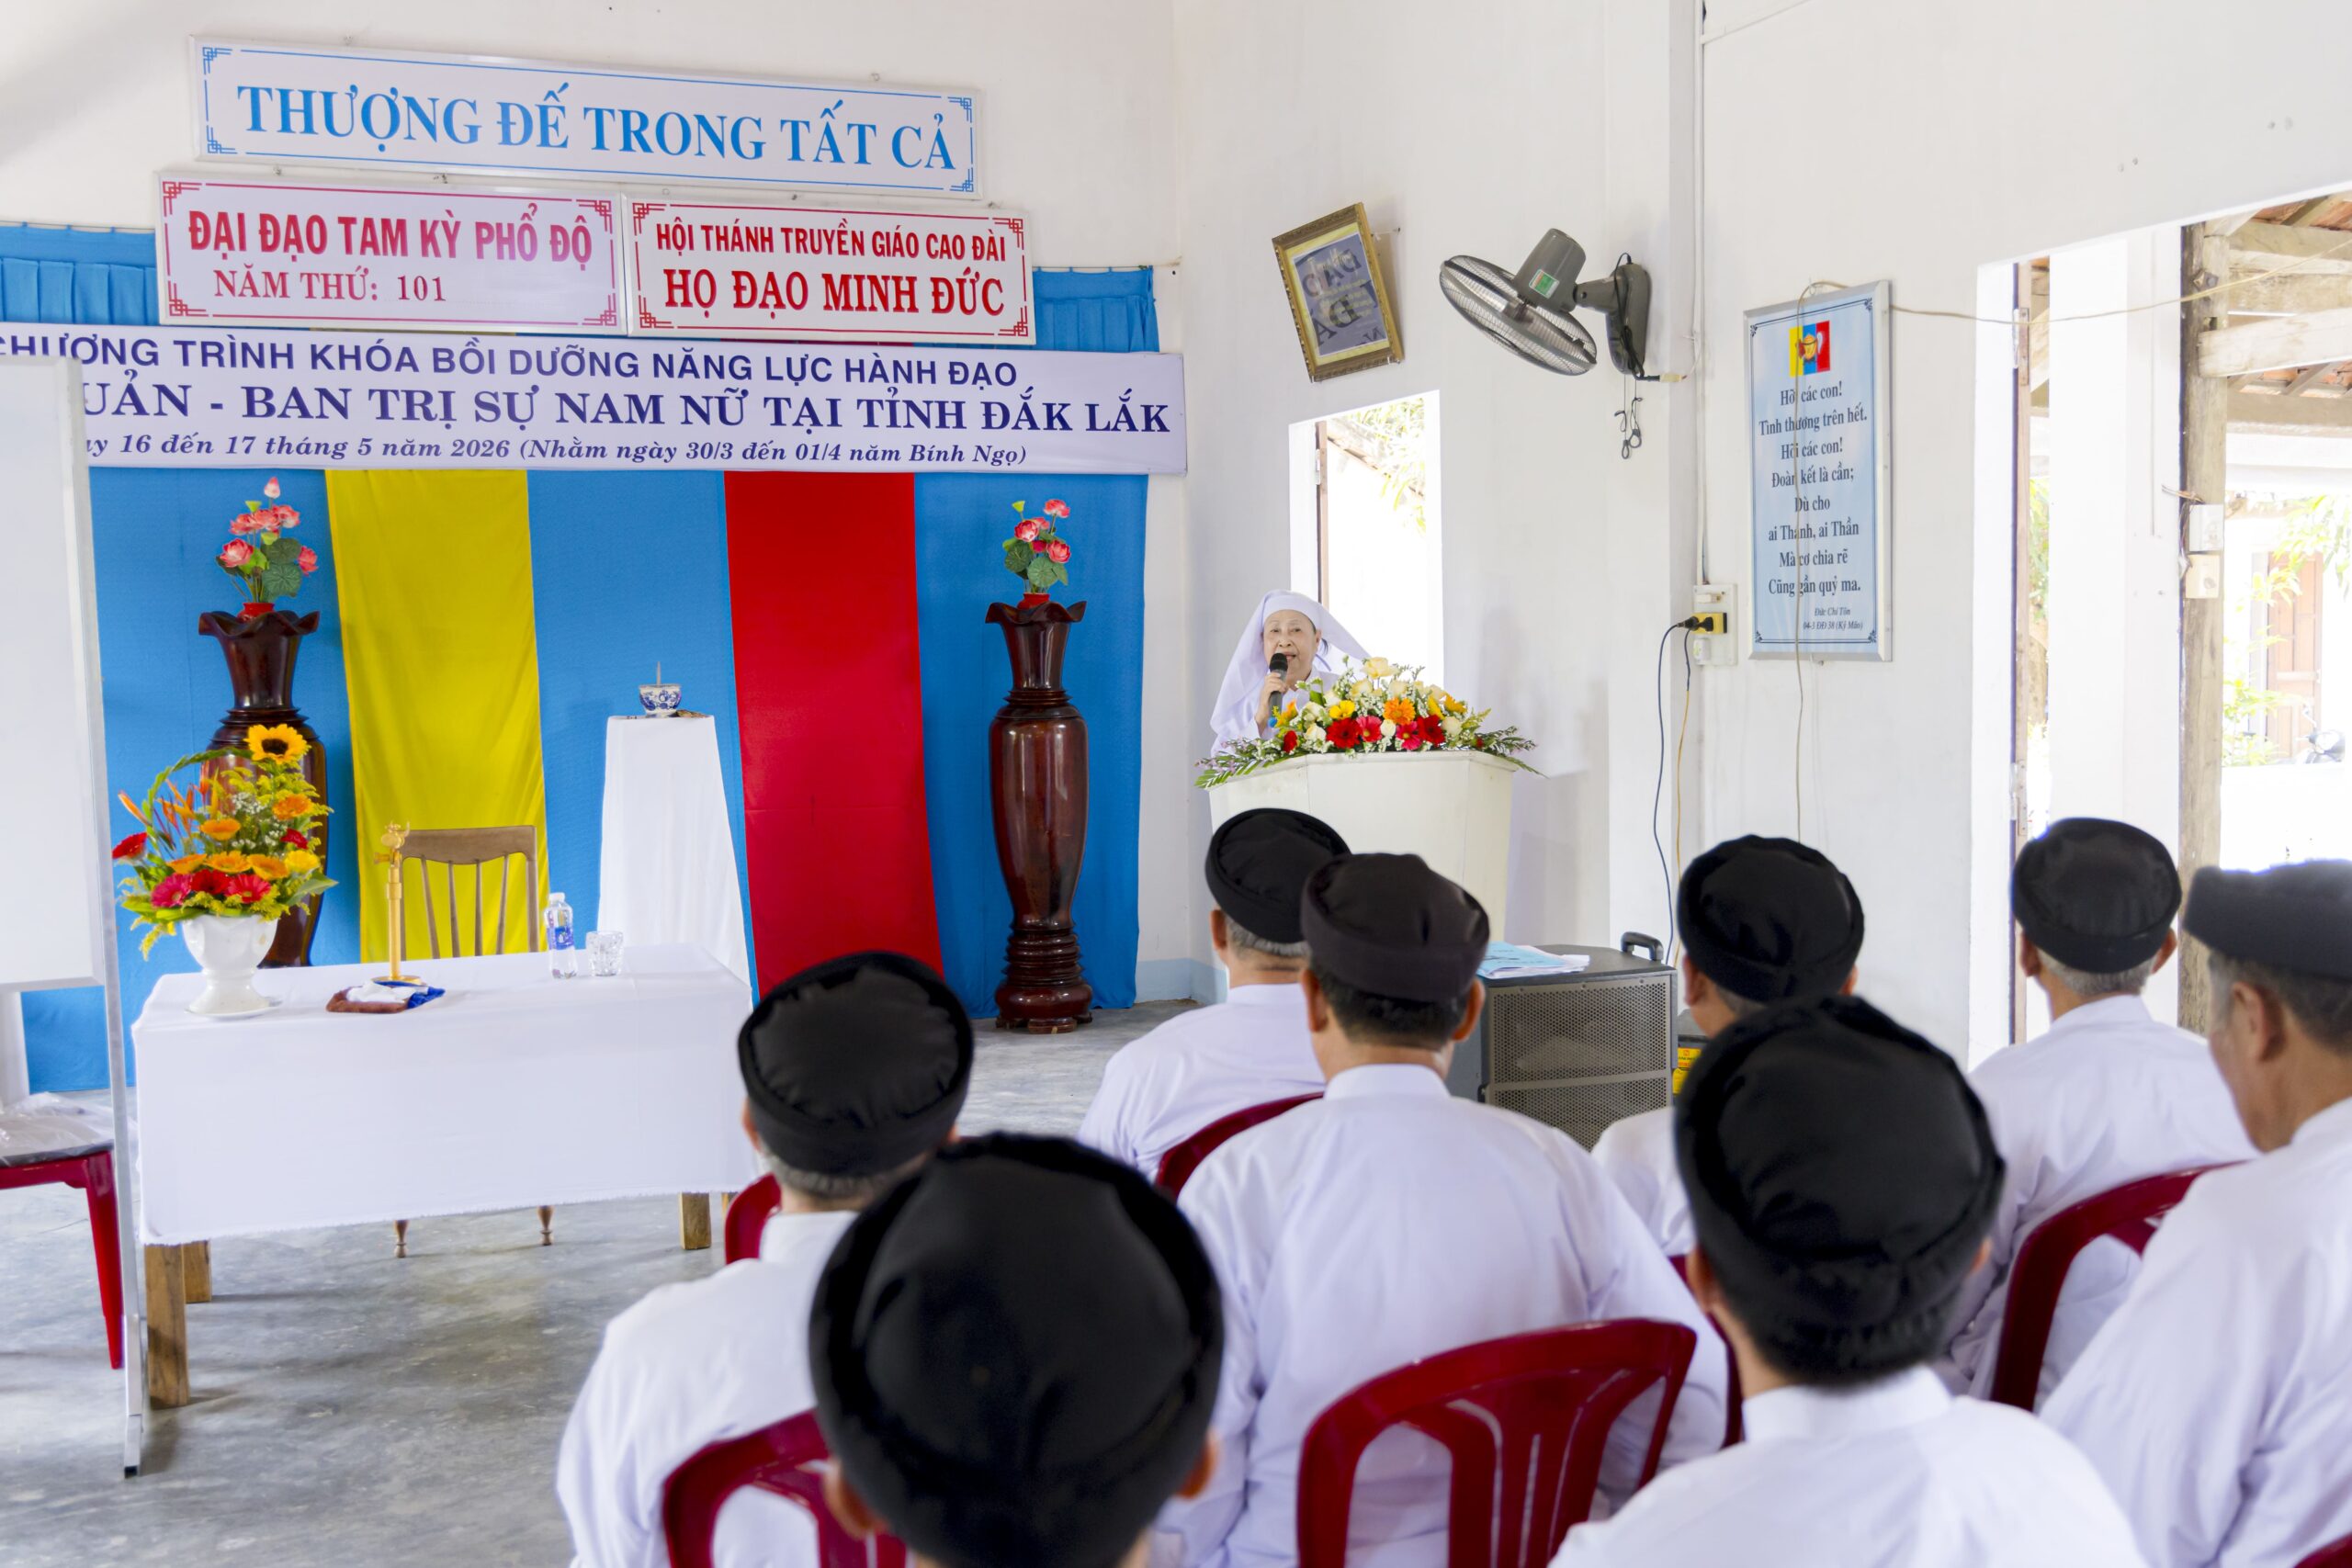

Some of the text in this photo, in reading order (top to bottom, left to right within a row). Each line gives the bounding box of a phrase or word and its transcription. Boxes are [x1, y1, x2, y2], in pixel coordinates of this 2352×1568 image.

[237, 82, 956, 170] THƯỢNG ĐẾ TRONG TẤT CẢ
[188, 202, 593, 271] ĐẠI ĐẠO TAM KỲ PHỔ ĐỘ
[656, 217, 1006, 262] HỘI THÁNH TRUYỀN GIÁO CAO ĐÀI
[214, 263, 447, 302] NĂM THỨ: 101
[662, 266, 1004, 320] HỌ ĐẠO MINH ĐỨC
[174, 334, 294, 369] TRÌNH
[311, 338, 420, 373] KHÓA
[432, 336, 495, 375] BỒI
[510, 344, 639, 378] DƯỠNG
[653, 347, 752, 380] NĂNG
[765, 355, 832, 387] LỰC
[845, 353, 936, 385] HÀNH
[948, 360, 1017, 390] ĐẠO
[82, 369, 192, 417] UẢN
[242, 386, 352, 420] BAN
[368, 388, 457, 429] TRỊ
[474, 385, 539, 431] SỰ
[555, 392, 663, 425] NAM
[680, 388, 749, 426] NỮ
[763, 397, 842, 434] TẠI
[857, 387, 968, 430] TỈNH
[981, 386, 1073, 432] ĐẮK
[1084, 388, 1170, 433] LẮK
[1801, 385, 1817, 402] các
[1820, 380, 1842, 401] con!
[1758, 418, 1782, 436] Tình
[1823, 409, 1845, 427] trên
[1847, 401, 1868, 423] hết.
[119, 434, 151, 454] 16
[161, 432, 214, 455] đến
[226, 435, 256, 455] 17
[266, 435, 349, 460] tháng
[357, 437, 372, 457] 5
[381, 441, 442, 457] năm
[450, 440, 510, 458] 2026
[520, 435, 607, 460] (Nhằm
[616, 443, 677, 463] ngày
[686, 442, 733, 461] 30/3
[742, 440, 786, 460] đến
[795, 443, 841, 462] 01/4
[849, 446, 901, 462] năm
[909, 442, 965, 463] Bính
[972, 445, 1026, 467] Ngọ)
[1802, 441, 1818, 457] các
[1821, 436, 1843, 455] con!
[1801, 464, 1816, 485] kết
[1819, 467, 1828, 482] là
[1794, 494, 1830, 513] Dù cho
[1769, 525, 1778, 541] ai
[1818, 521, 1828, 537] ai
[1831, 516, 1860, 536] Thần
[1779, 550, 1796, 568] Mà
[1813, 548, 1834, 566] chia
[1837, 548, 1848, 564] rẽ
[1769, 579, 1795, 597] Cũng
[1841, 579, 1861, 592] ma.
